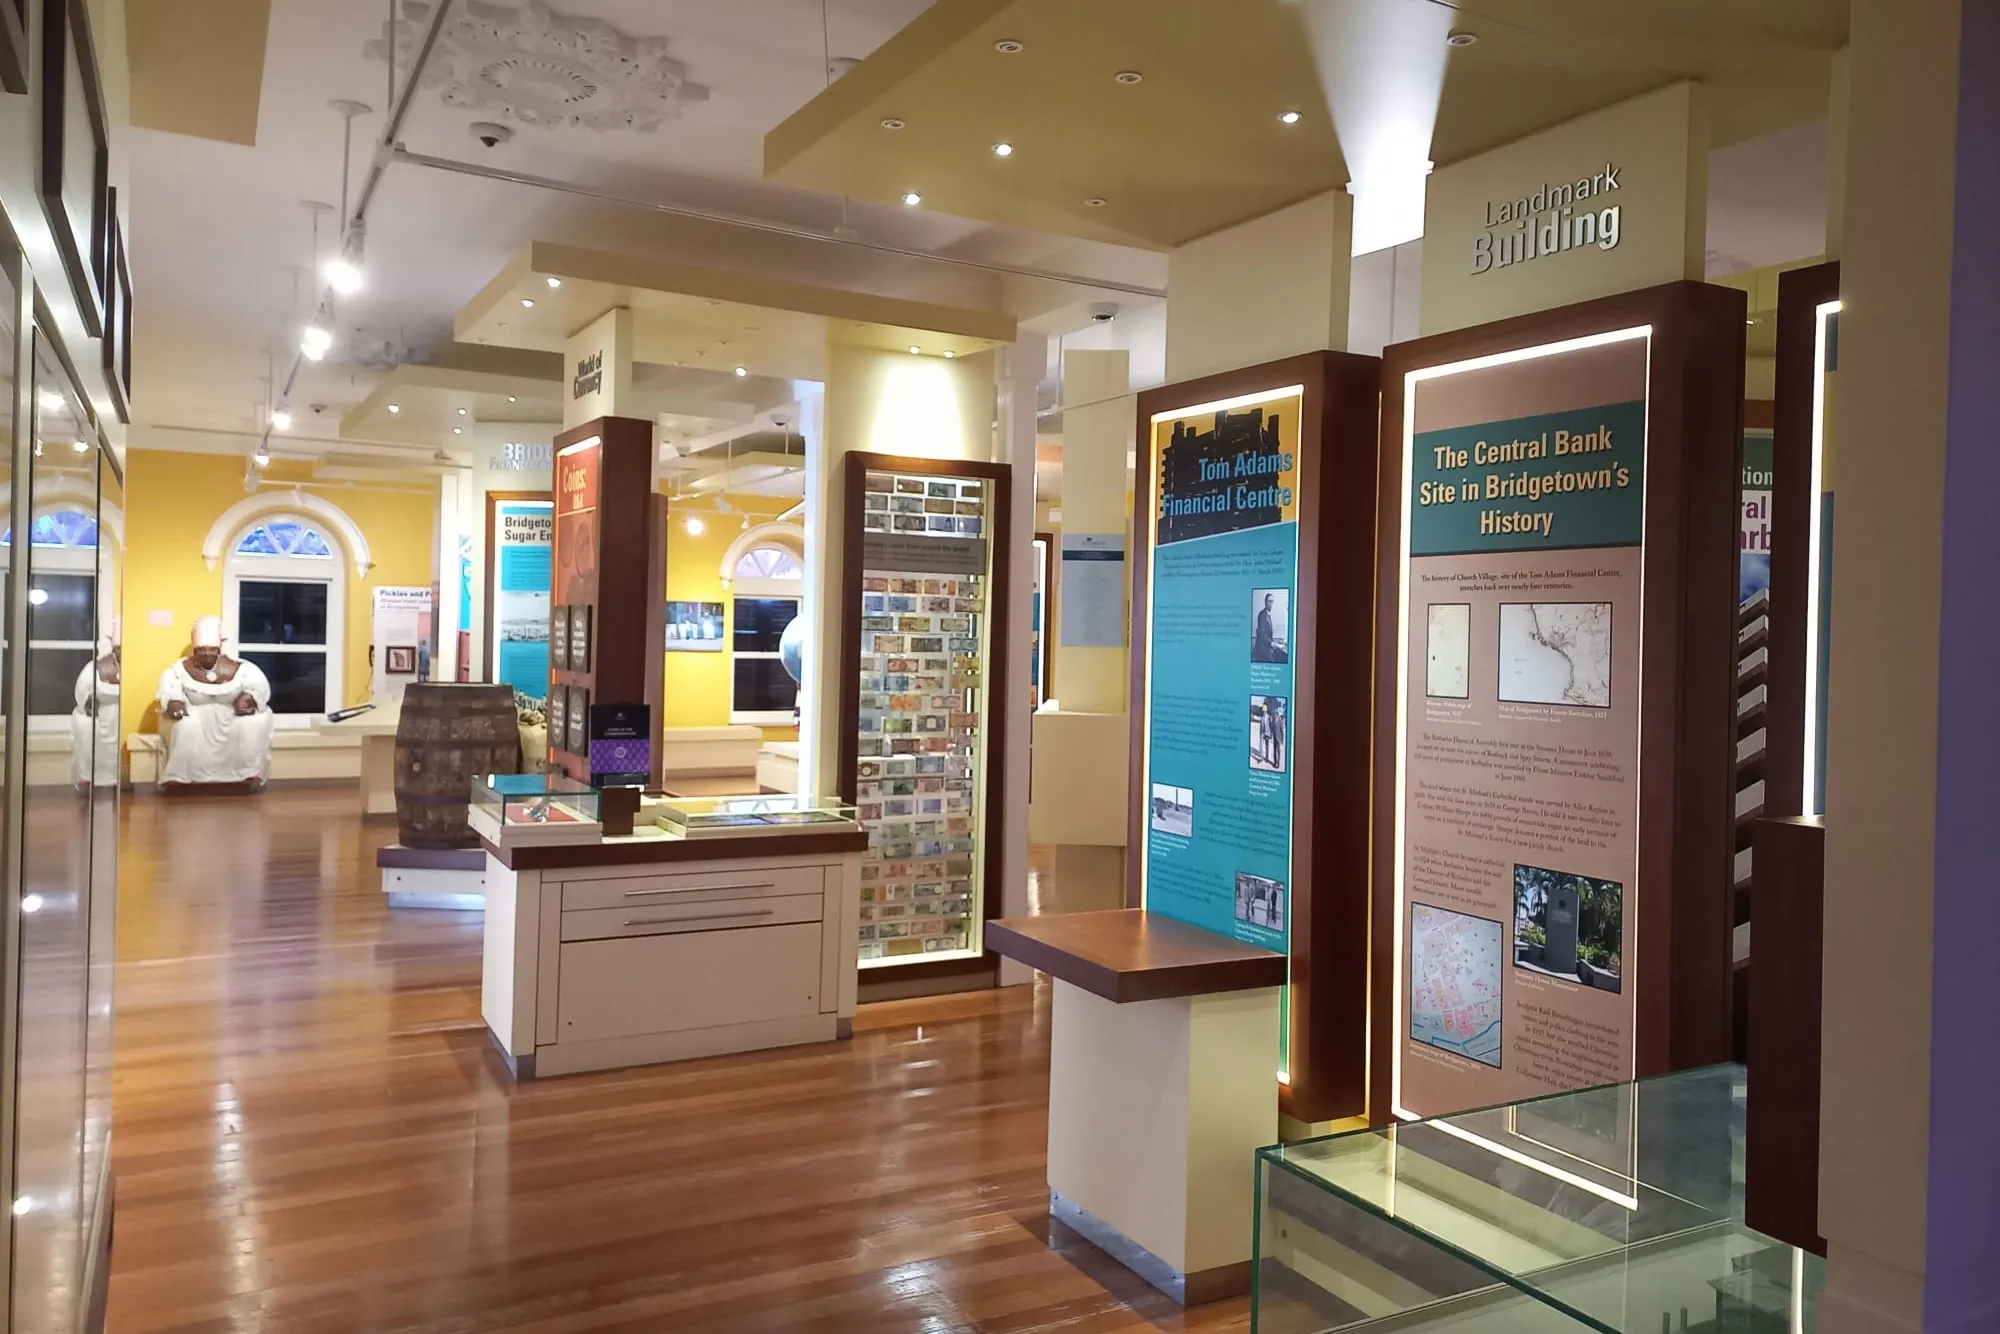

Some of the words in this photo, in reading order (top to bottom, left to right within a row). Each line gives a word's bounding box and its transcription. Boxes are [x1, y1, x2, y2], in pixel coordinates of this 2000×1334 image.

[1485, 163, 1621, 229] Landmark
[1471, 205, 1623, 275] Building
[1434, 446, 1468, 470] The
[1474, 433, 1548, 465] Central
[1554, 424, 1613, 456] Bank
[1199, 457, 1230, 482] Tom
[1234, 452, 1293, 476] Adams
[1420, 481, 1457, 506] Site
[1461, 478, 1480, 500] in
[1485, 461, 1630, 500] Bridgetown's
[1161, 493, 1232, 517] Financial
[1236, 486, 1293, 508] Centre
[1741, 495, 1767, 519] al
[505, 530, 537, 543] Sugar
[1480, 509, 1554, 537] History
[1457, 572, 1477, 581] Church
[1518, 569, 1528, 580] the
[1528, 571, 1543, 579] Tom
[1544, 569, 1565, 579] Adams
[1565, 568, 1597, 578] Financial
